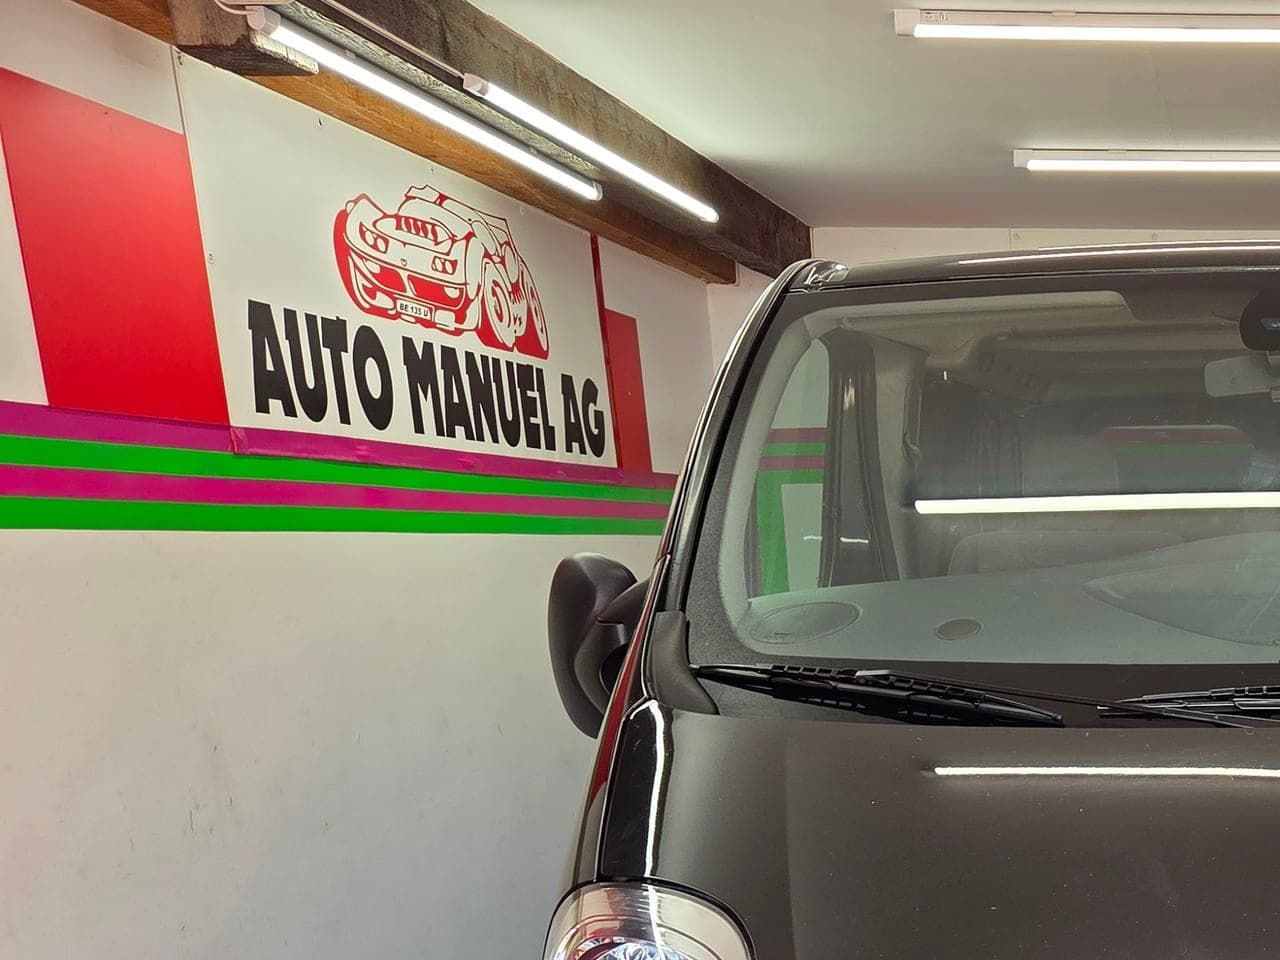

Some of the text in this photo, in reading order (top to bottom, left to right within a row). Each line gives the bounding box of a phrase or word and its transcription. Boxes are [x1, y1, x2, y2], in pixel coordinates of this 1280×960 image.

[247, 298, 606, 458] AUTO MANUEL AG
